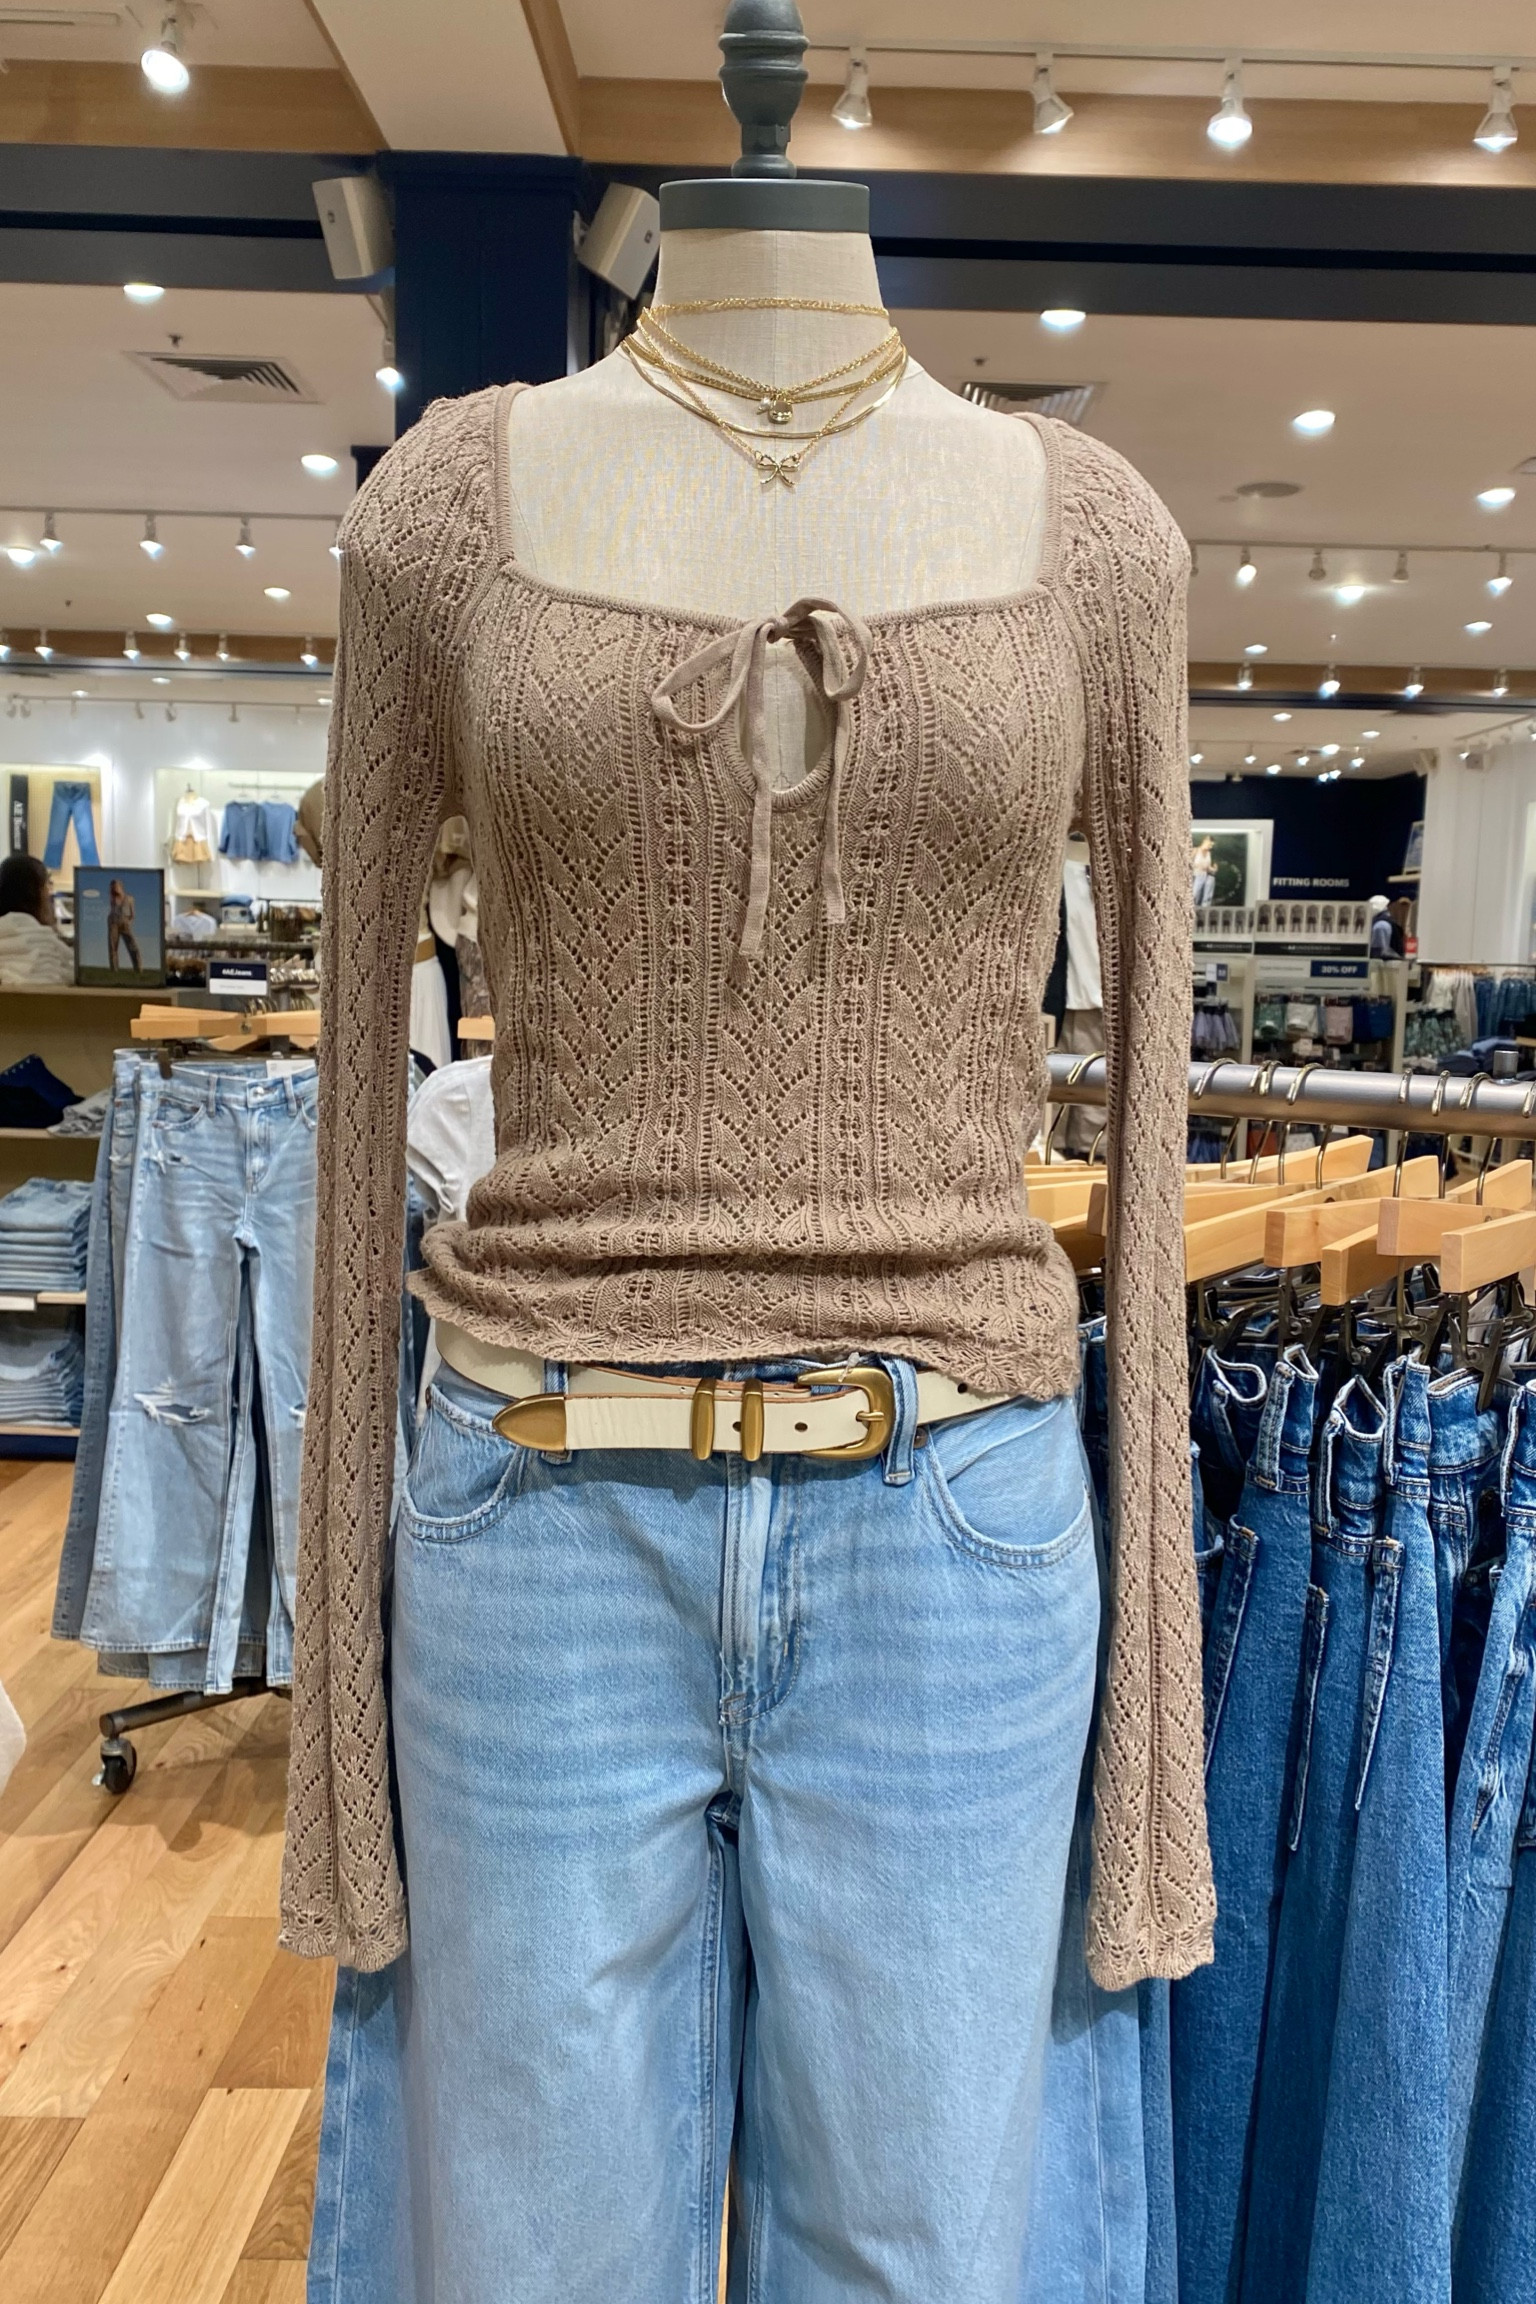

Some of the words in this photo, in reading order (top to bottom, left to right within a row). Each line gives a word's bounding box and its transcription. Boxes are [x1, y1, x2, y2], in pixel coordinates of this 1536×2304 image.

[1273, 877, 1310, 887] FITTING
[1312, 878, 1350, 888] ROOMS
[1341, 965, 1358, 974] OFF
